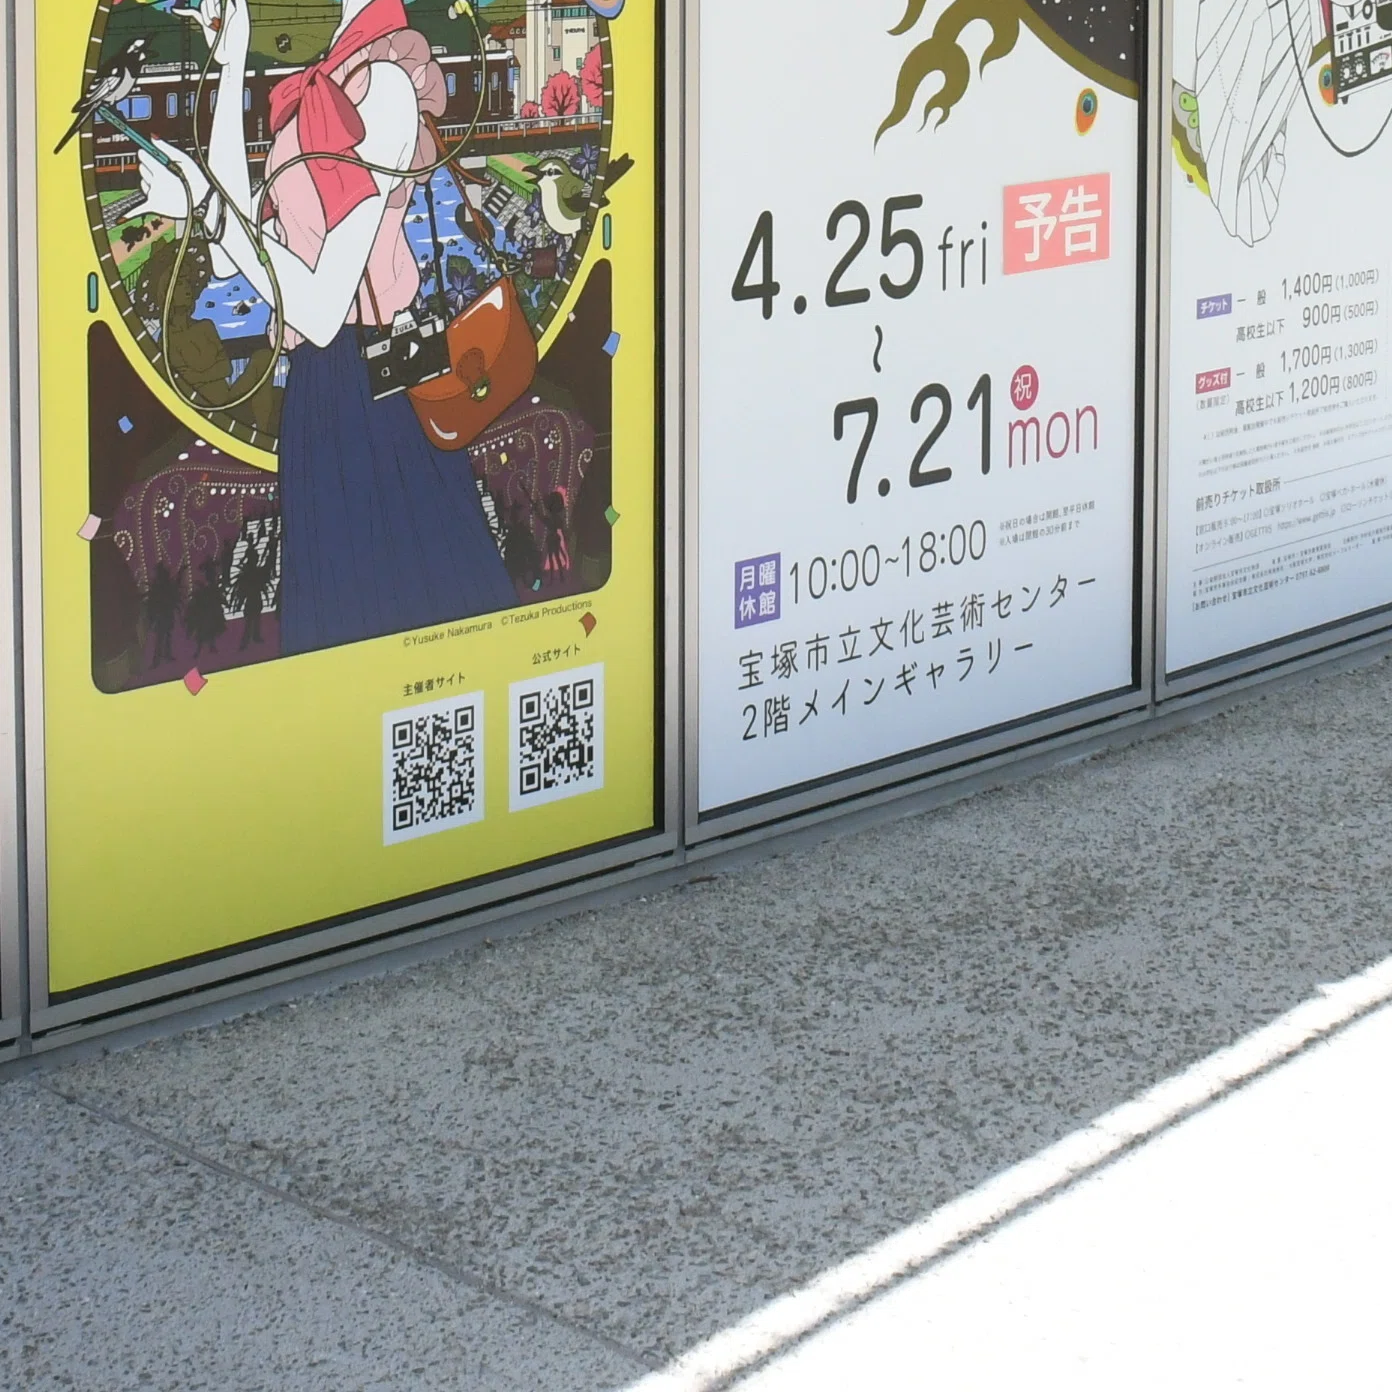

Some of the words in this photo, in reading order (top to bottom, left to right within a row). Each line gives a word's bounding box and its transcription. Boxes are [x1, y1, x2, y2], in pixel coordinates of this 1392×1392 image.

[1014, 186, 1102, 262] 予告
[732, 194, 923, 320] 4.25
[938, 222, 987, 292] fri
[1200, 298, 1228, 314] チケット
[1281, 273, 1332, 300] 1,400円
[1236, 318, 1285, 342] 高校生以下
[1303, 303, 1340, 328] 900円
[1014, 373, 1032, 401] 祝
[1198, 373, 1227, 390] グッズ付
[1280, 344, 1331, 374] 1,700円
[1235, 390, 1284, 416] 高校生以下
[1289, 374, 1340, 404] 1,200円
[833, 373, 992, 504] 7.21
[1008, 404, 1098, 468] mon
[739, 560, 776, 592] 月曜
[447, 621, 492, 639] Nakamura
[542, 600, 592, 617] Productions
[739, 590, 776, 621] 休館
[738, 574, 1096, 690] 宝塚市立文化芸術センター
[532, 644, 581, 665] 公式サイト
[404, 672, 465, 696] 主催者サイト
[742, 642, 1033, 742] 2階メインギャラリー
